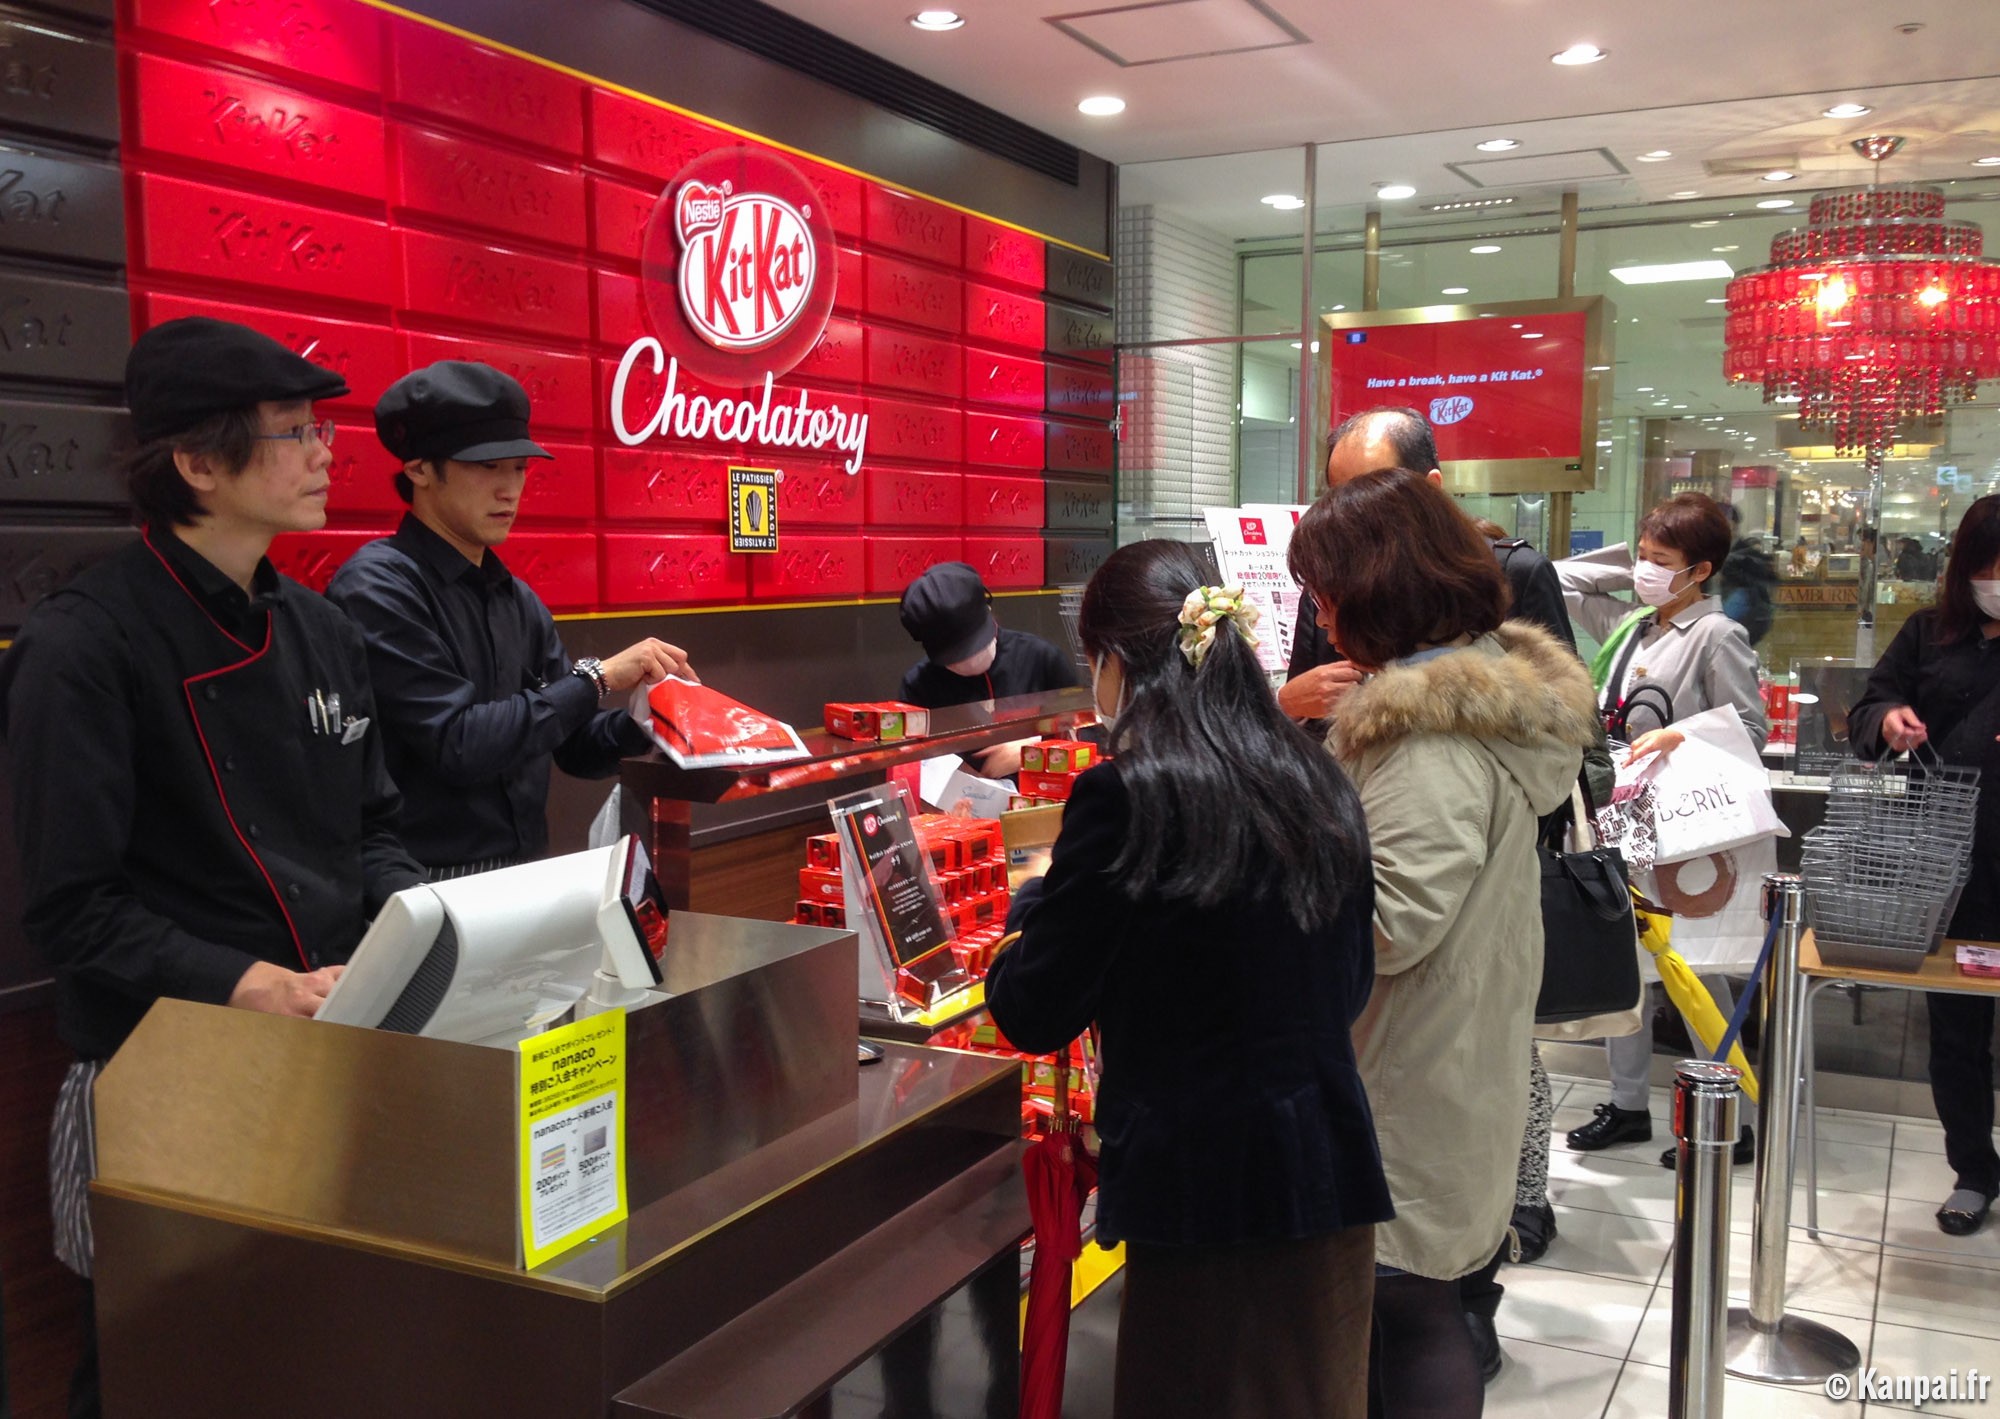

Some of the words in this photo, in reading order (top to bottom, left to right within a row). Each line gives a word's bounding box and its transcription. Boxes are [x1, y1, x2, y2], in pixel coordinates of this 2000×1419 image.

[1367, 378, 1395, 388] Have
[1398, 379, 1406, 387] a
[1408, 375, 1445, 387] break,
[1448, 373, 1477, 385] have
[1479, 373, 1488, 382] a
[1491, 371, 1509, 382] Kit
[610, 335, 869, 476] Chocolatory
[732, 472, 740, 482] LE
[742, 473, 774, 484] PATISSIER
[732, 483, 740, 536] TAKAGI
[734, 537, 766, 547] PATISSIER
[552, 1047, 596, 1072] nanaco
